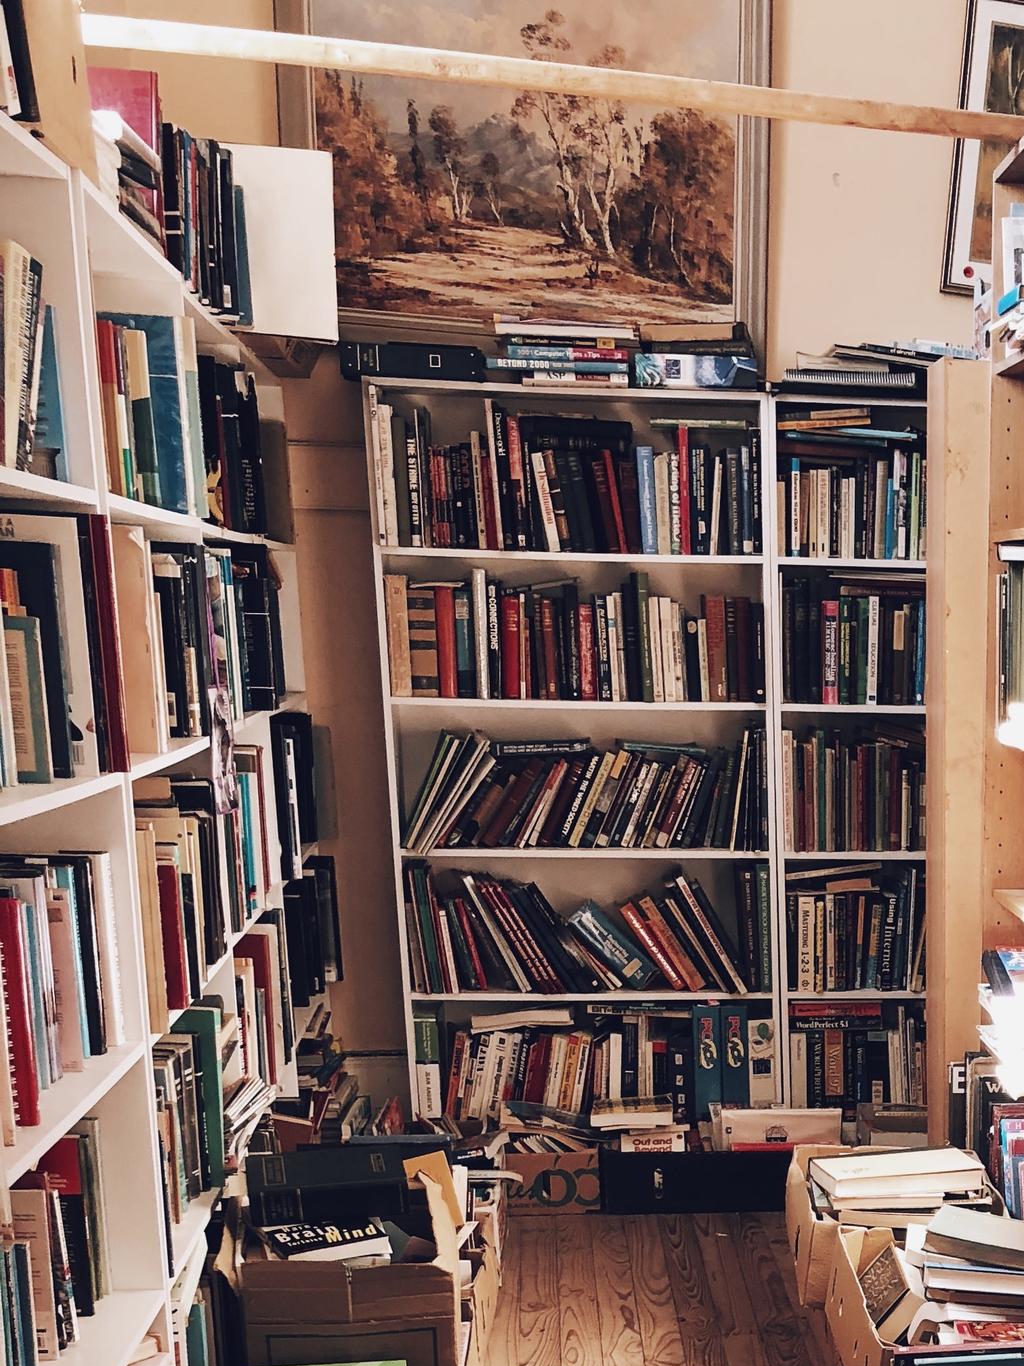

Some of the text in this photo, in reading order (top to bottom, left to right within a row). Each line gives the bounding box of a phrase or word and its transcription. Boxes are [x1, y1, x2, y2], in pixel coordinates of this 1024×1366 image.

[881, 925, 896, 973] Internet
[632, 1137, 673, 1146] Out and
[273, 1223, 336, 1245] Brain
[324, 1223, 378, 1244] Mind
